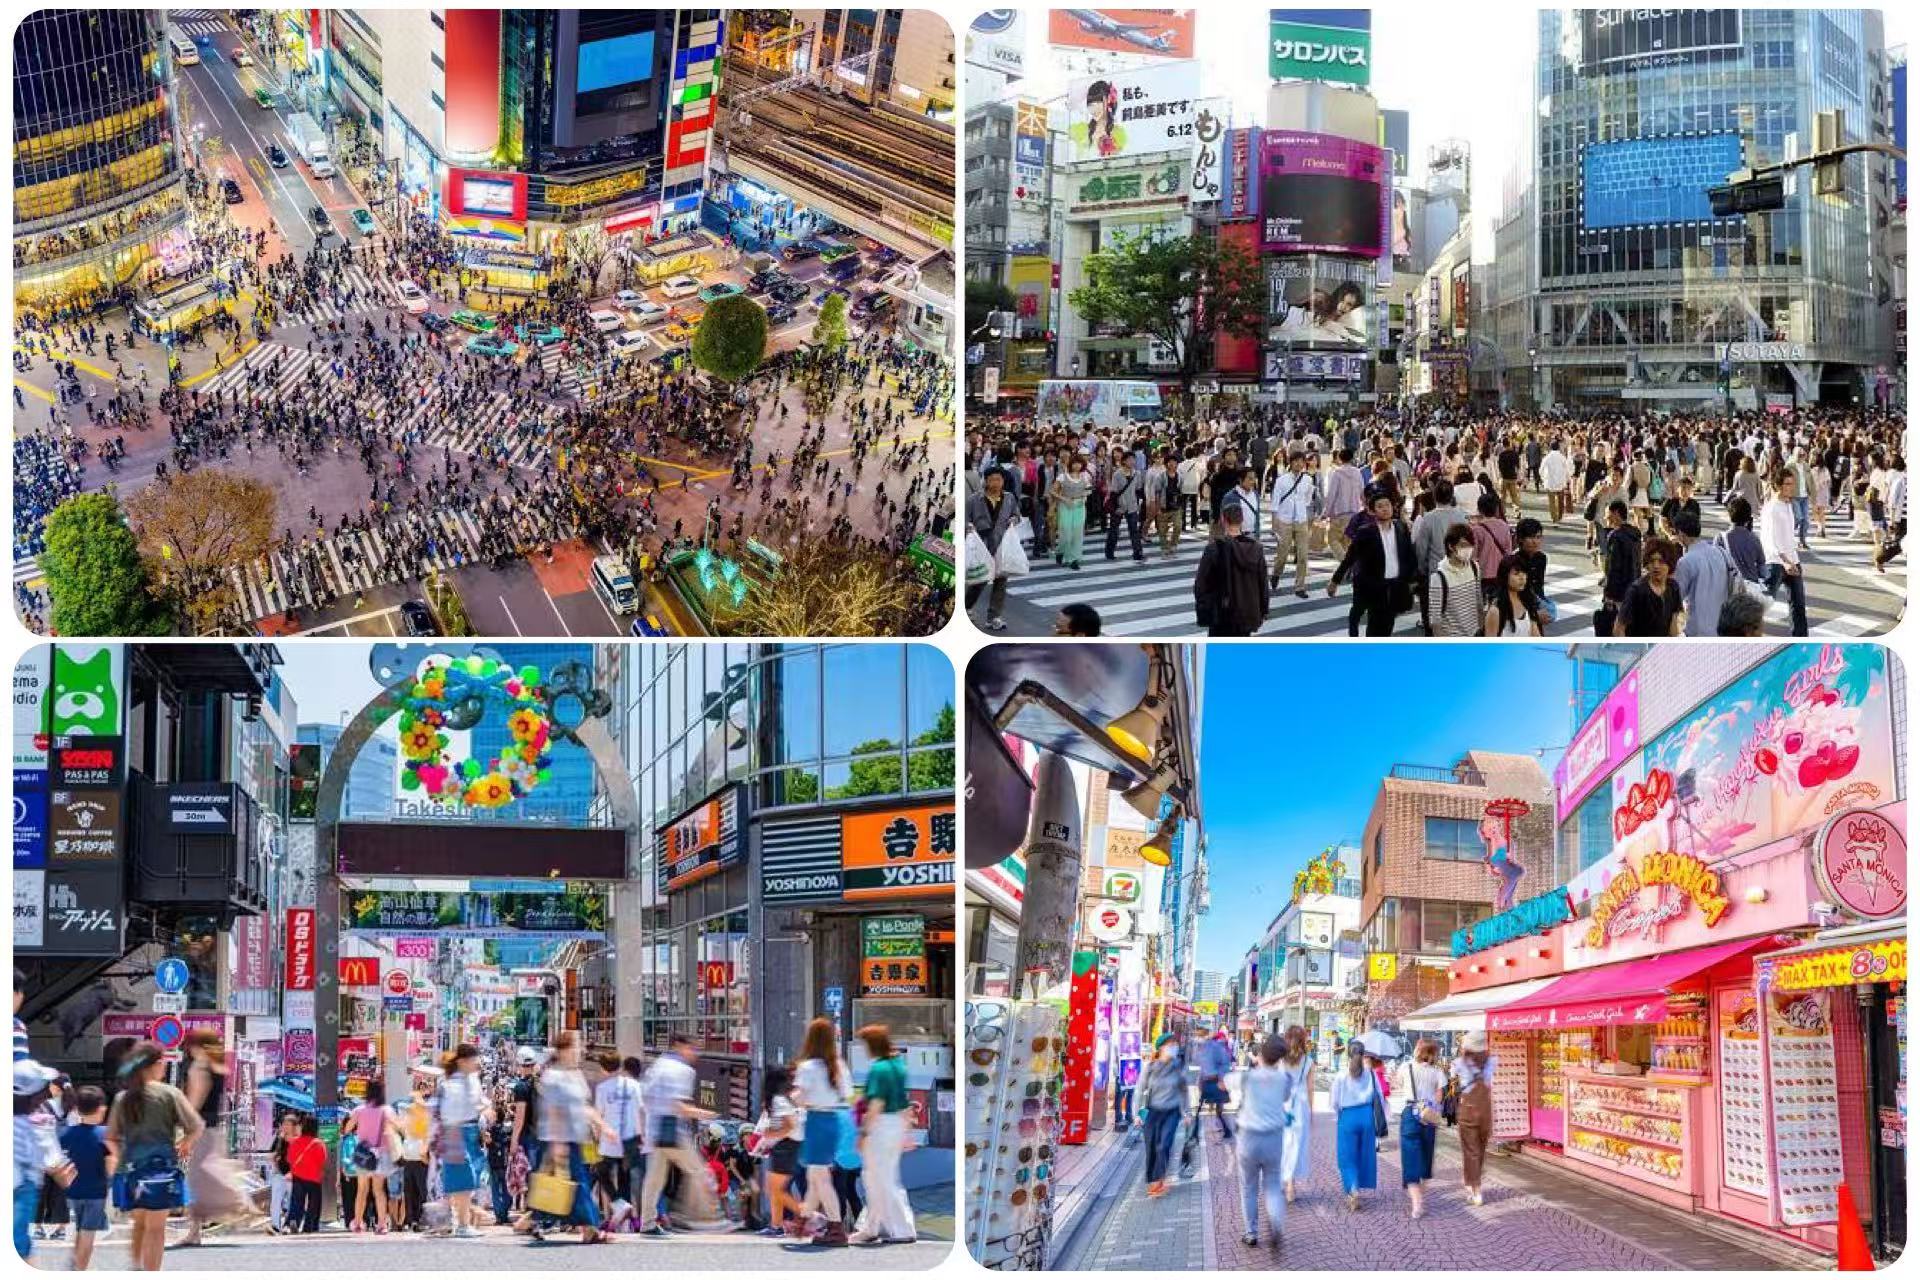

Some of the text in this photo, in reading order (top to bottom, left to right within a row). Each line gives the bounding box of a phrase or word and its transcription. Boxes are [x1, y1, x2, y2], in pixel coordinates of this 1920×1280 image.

[1273, 39, 1367, 66] サロンパス
[1167, 123, 1193, 138] 6.12
[1193, 108, 1222, 197] もんじゃ
[1716, 344, 1803, 359] TSUTAYA
[184, 812, 206, 820] 30m
[765, 874, 840, 891] YOSHINOYA
[1832, 858, 1904, 898] SANTA MONICA
[1783, 968, 1809, 983] MAX
